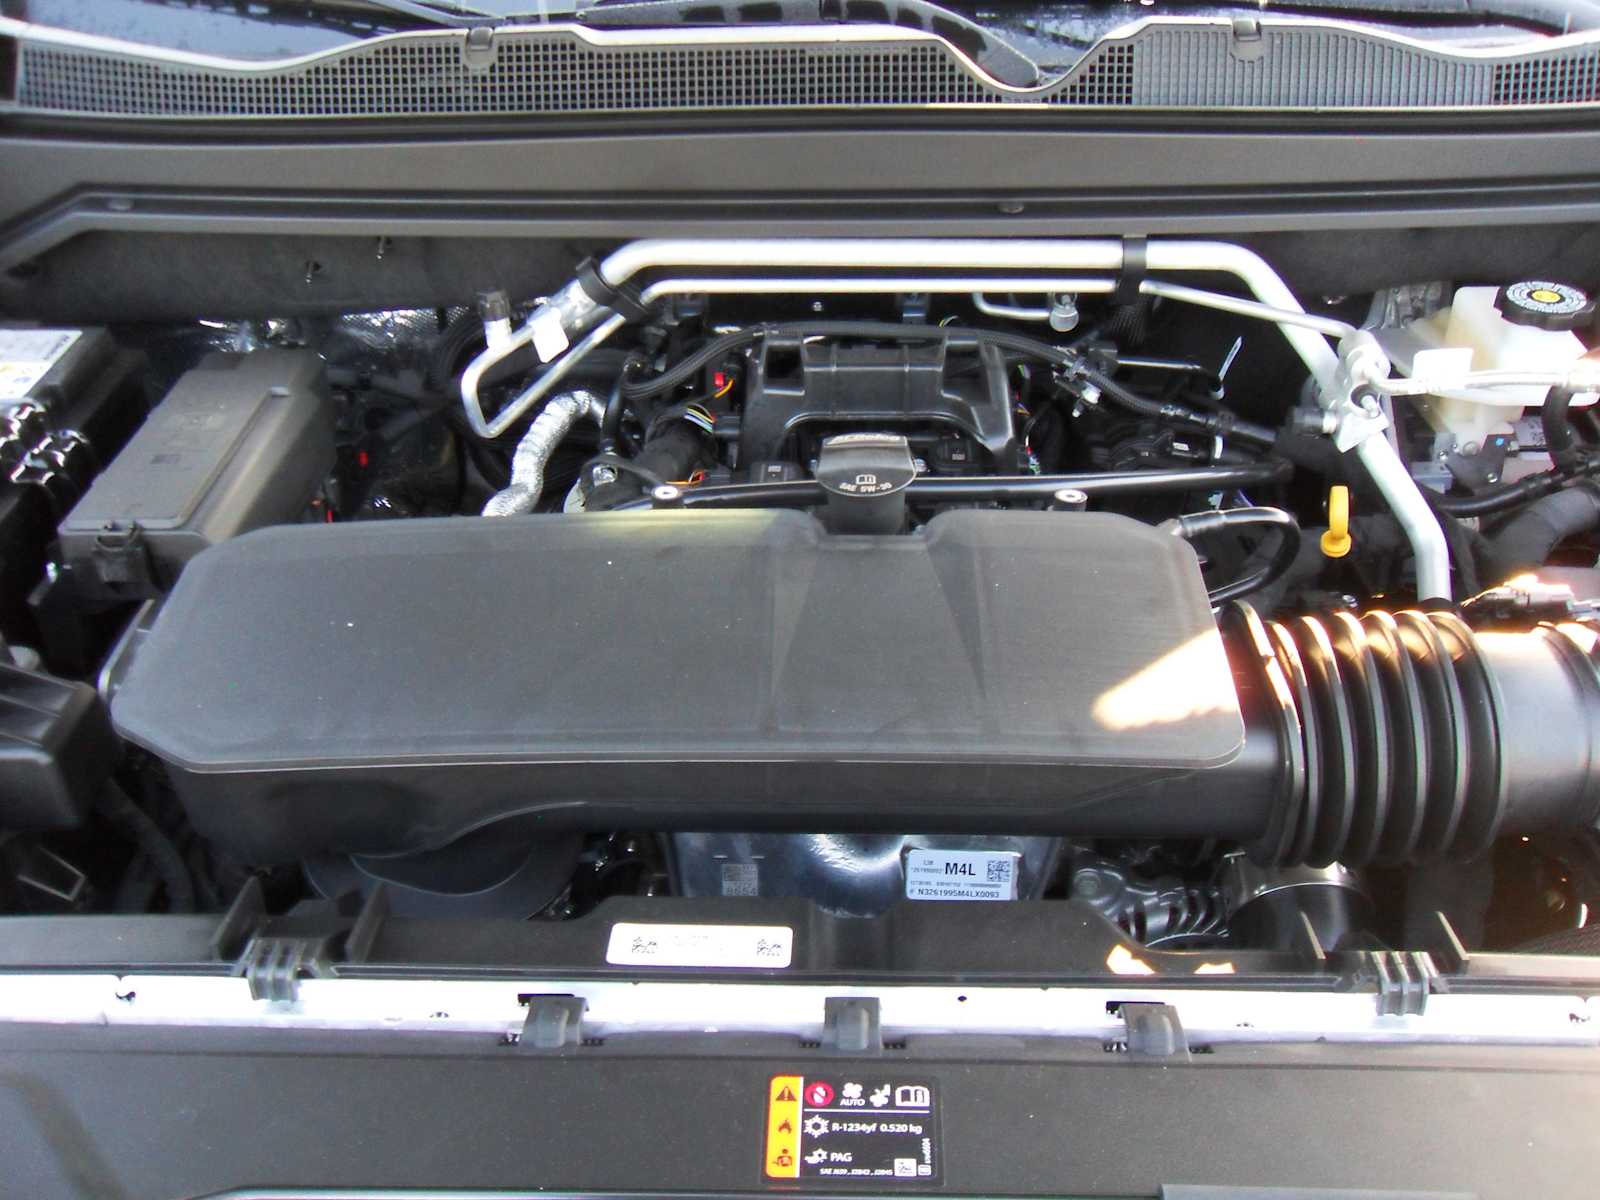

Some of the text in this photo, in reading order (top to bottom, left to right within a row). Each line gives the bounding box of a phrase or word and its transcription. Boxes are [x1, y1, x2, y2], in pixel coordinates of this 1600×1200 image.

[944, 862, 977, 876] M4L
[840, 1098, 865, 1106] AUTO
[831, 1122, 923, 1135] R-1234yf 0.520 kg
[830, 1152, 853, 1163] PAG
